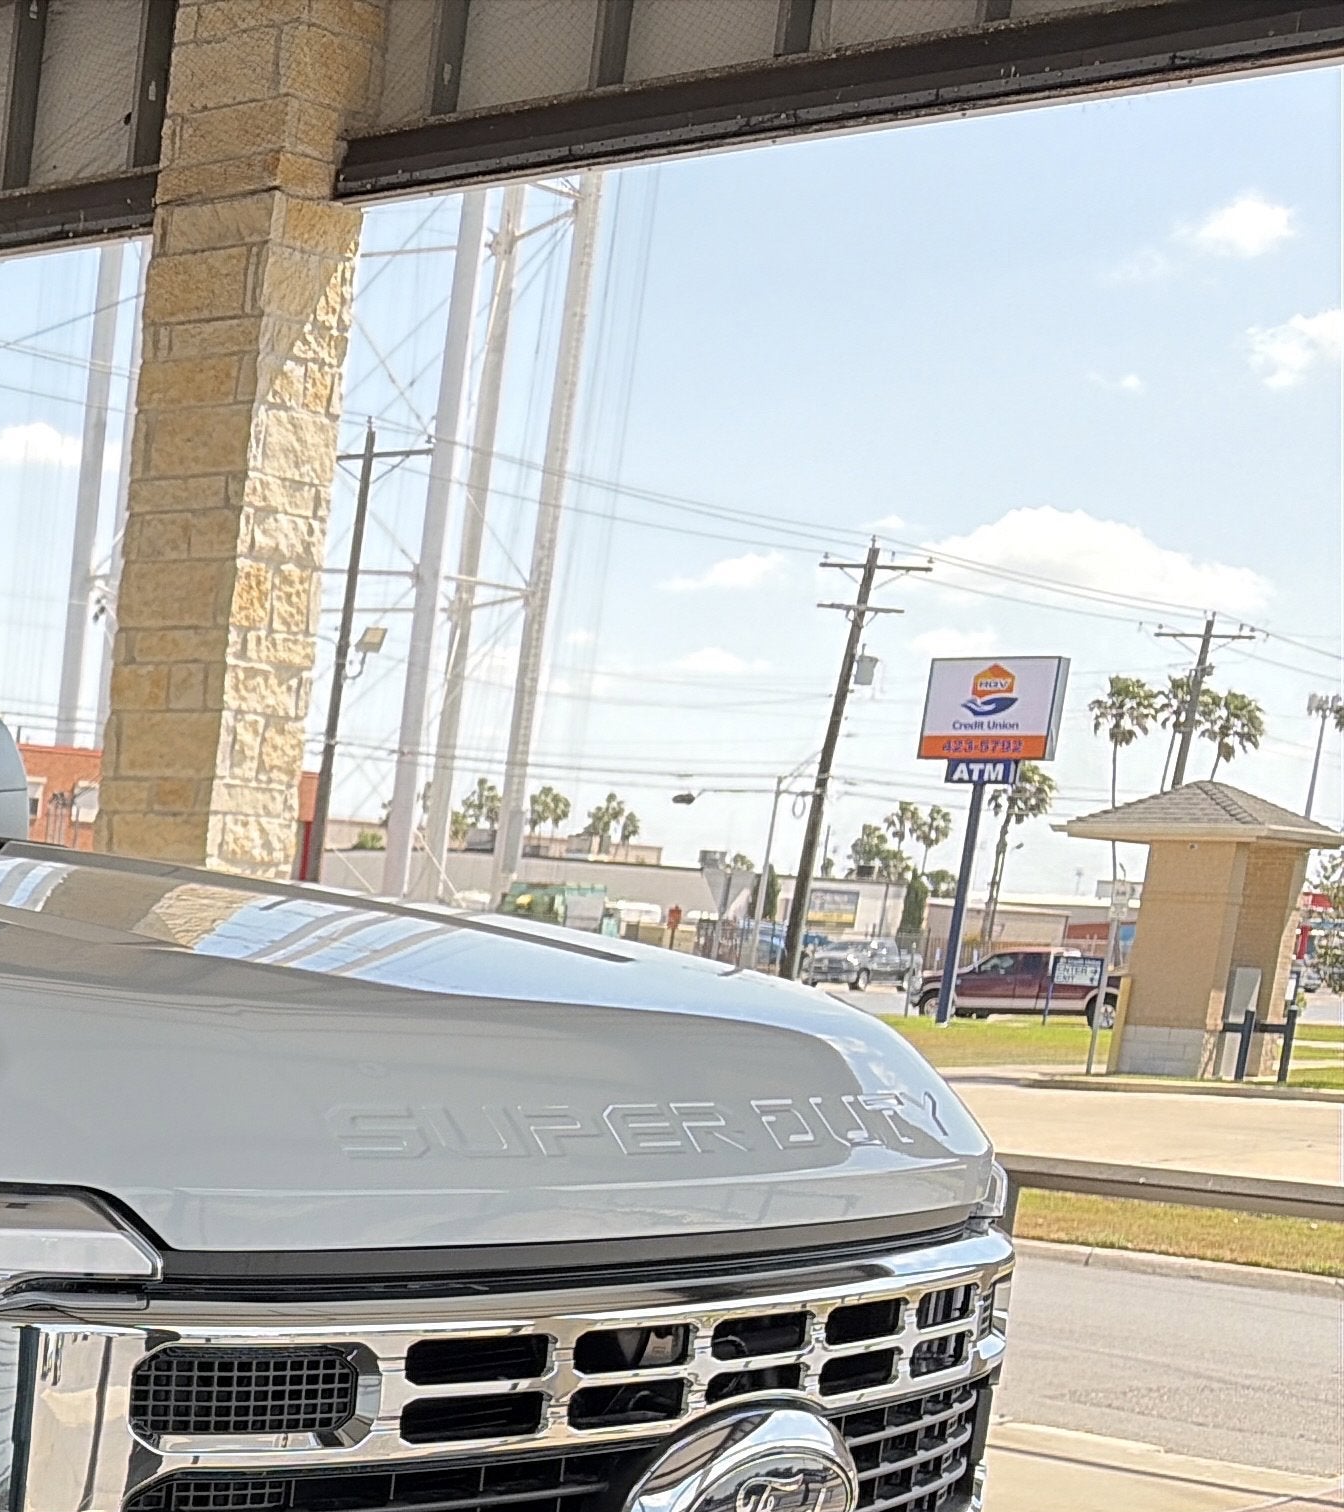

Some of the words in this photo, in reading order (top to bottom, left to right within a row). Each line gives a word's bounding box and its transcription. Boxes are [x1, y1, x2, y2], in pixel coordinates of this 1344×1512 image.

[952, 720, 984, 731] Credit
[987, 720, 1020, 731] Union
[952, 763, 1005, 782] ATM
[330, 1101, 752, 1159] SUPER
[752, 1090, 950, 1151] DUTY
